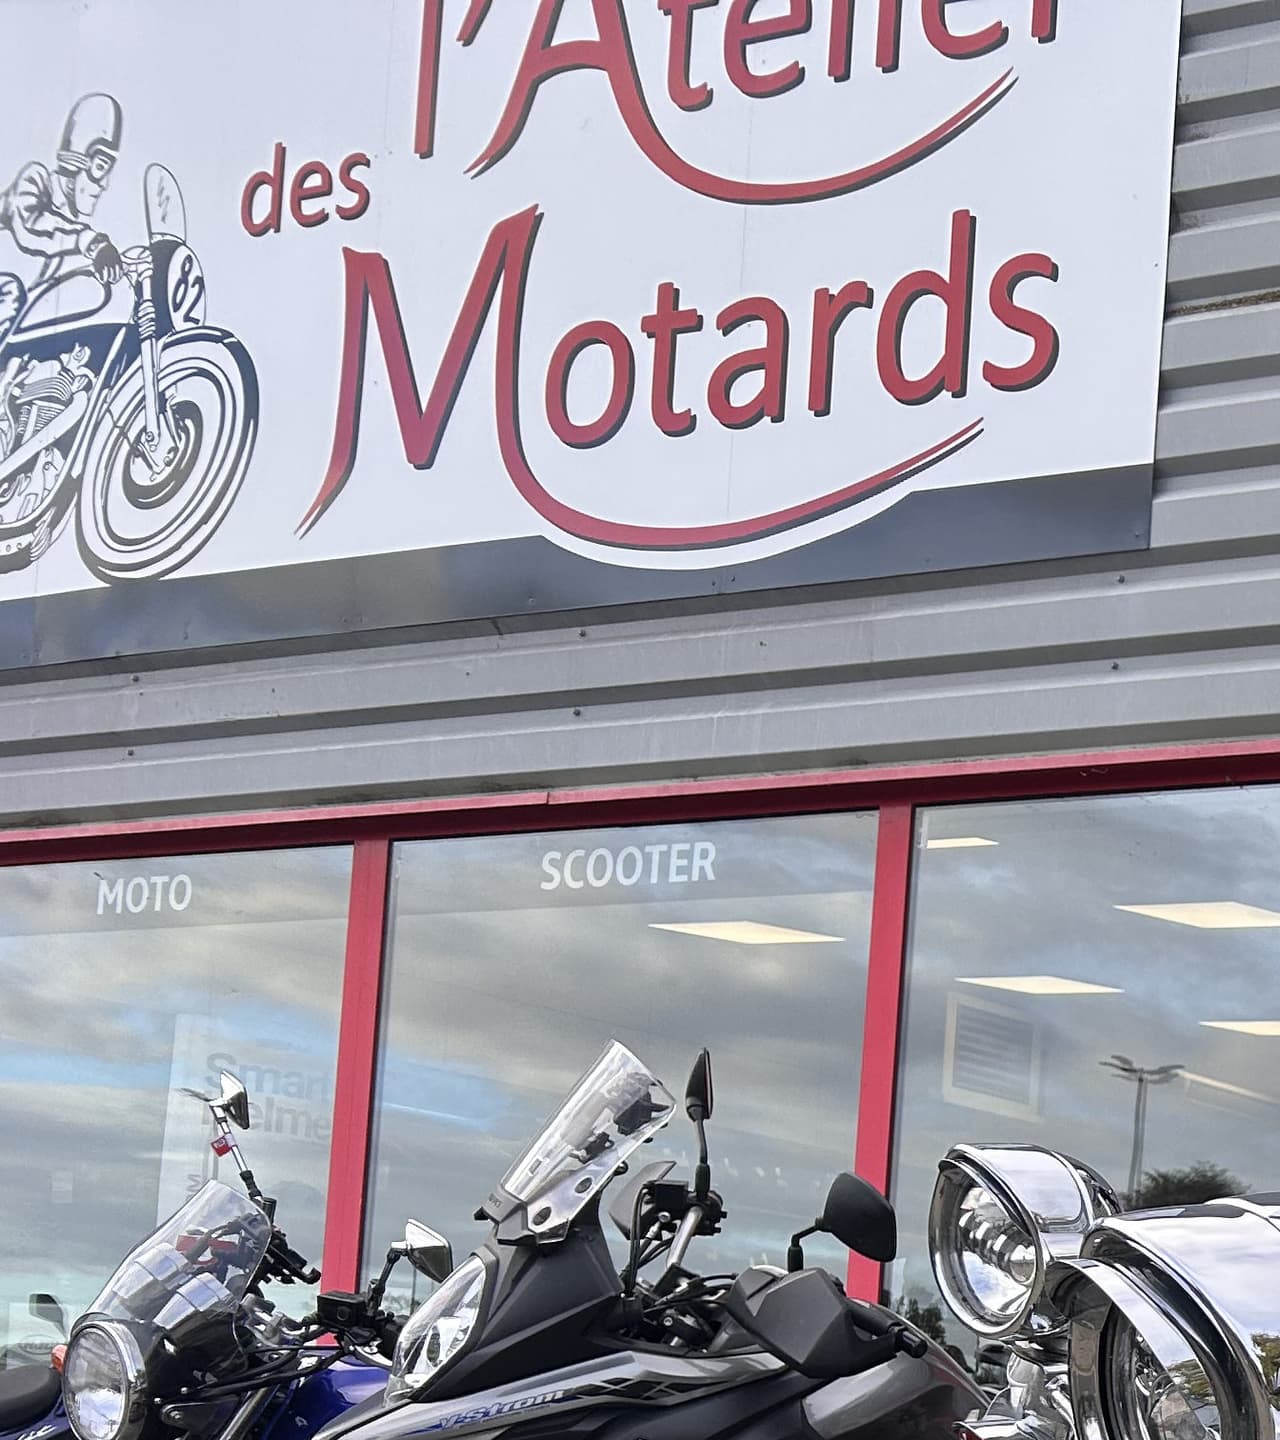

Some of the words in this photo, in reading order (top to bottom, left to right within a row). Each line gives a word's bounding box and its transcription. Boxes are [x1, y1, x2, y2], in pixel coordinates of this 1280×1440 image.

[240, 141, 374, 236] des
[296, 203, 1060, 549] Motards
[95, 874, 193, 916] MOTO
[539, 841, 717, 891] SCOOTER
